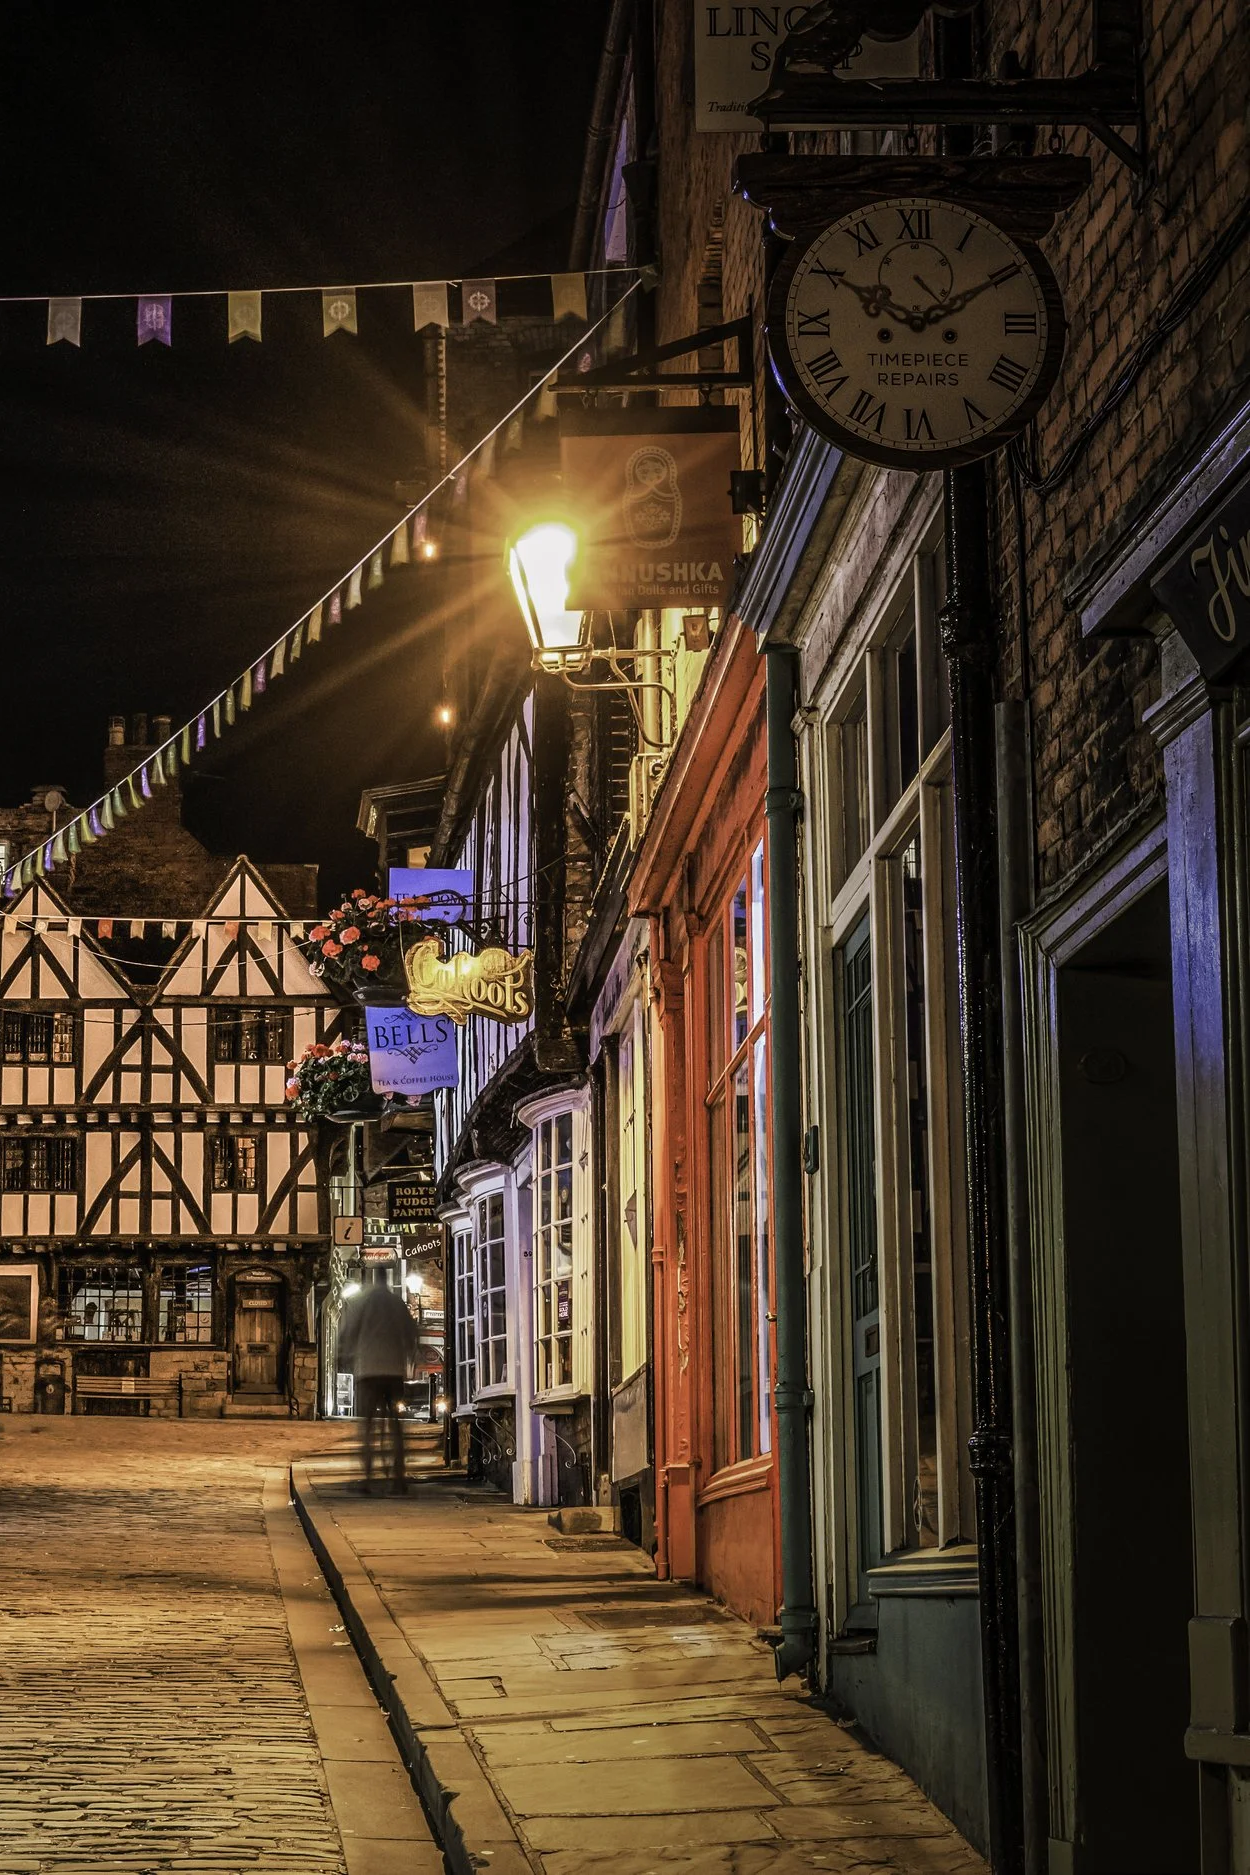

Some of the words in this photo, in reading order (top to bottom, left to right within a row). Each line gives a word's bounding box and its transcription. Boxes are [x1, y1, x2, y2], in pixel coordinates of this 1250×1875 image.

[867, 353, 969, 367] TIMEPIECE
[877, 373, 960, 386] REPAIRS
[638, 584, 666, 596] Dolls
[669, 584, 689, 595] and
[692, 583, 719, 594] Gifts
[395, 1187, 437, 1196] ROLY'S
[396, 1198, 435, 1206] FUDGE
[405, 1238, 441, 1258] Cahoots
